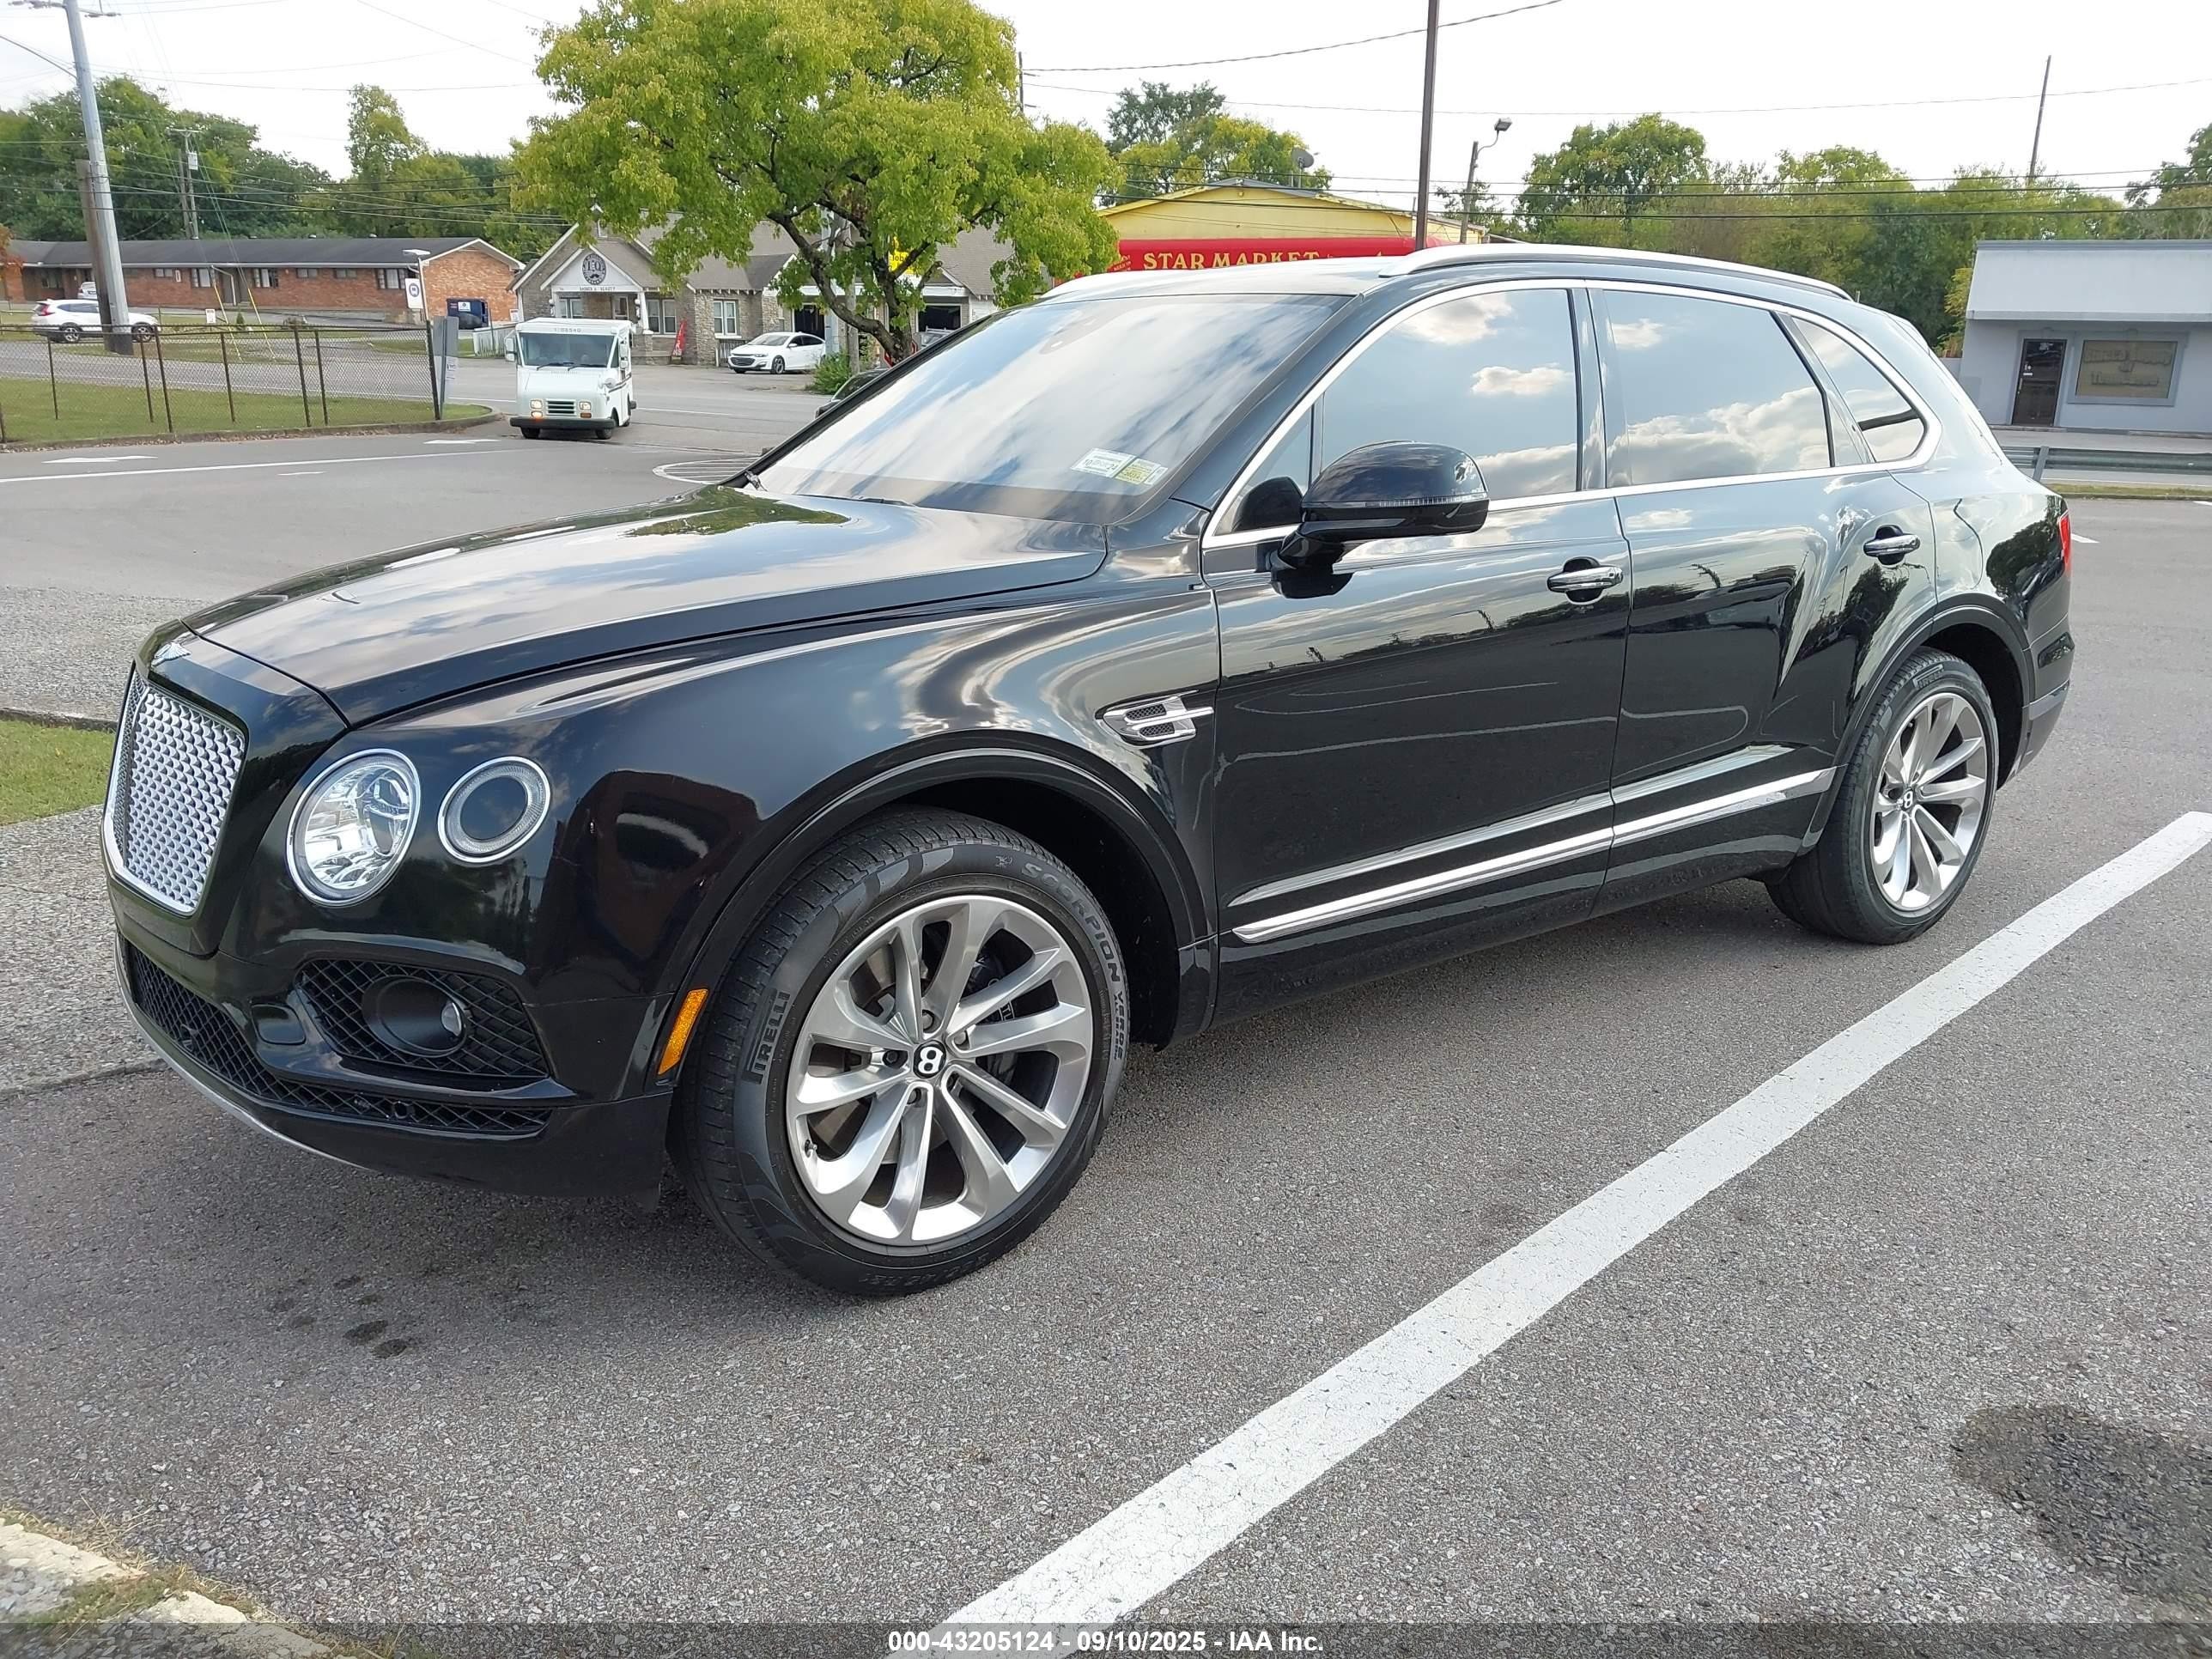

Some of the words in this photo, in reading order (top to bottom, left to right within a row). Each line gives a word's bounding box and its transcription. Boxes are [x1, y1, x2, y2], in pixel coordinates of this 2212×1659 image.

[1143, 252, 1205, 270] STAR
[1021, 862, 1121, 982] SCORPION
[742, 988, 791, 1085] PIRELLI
